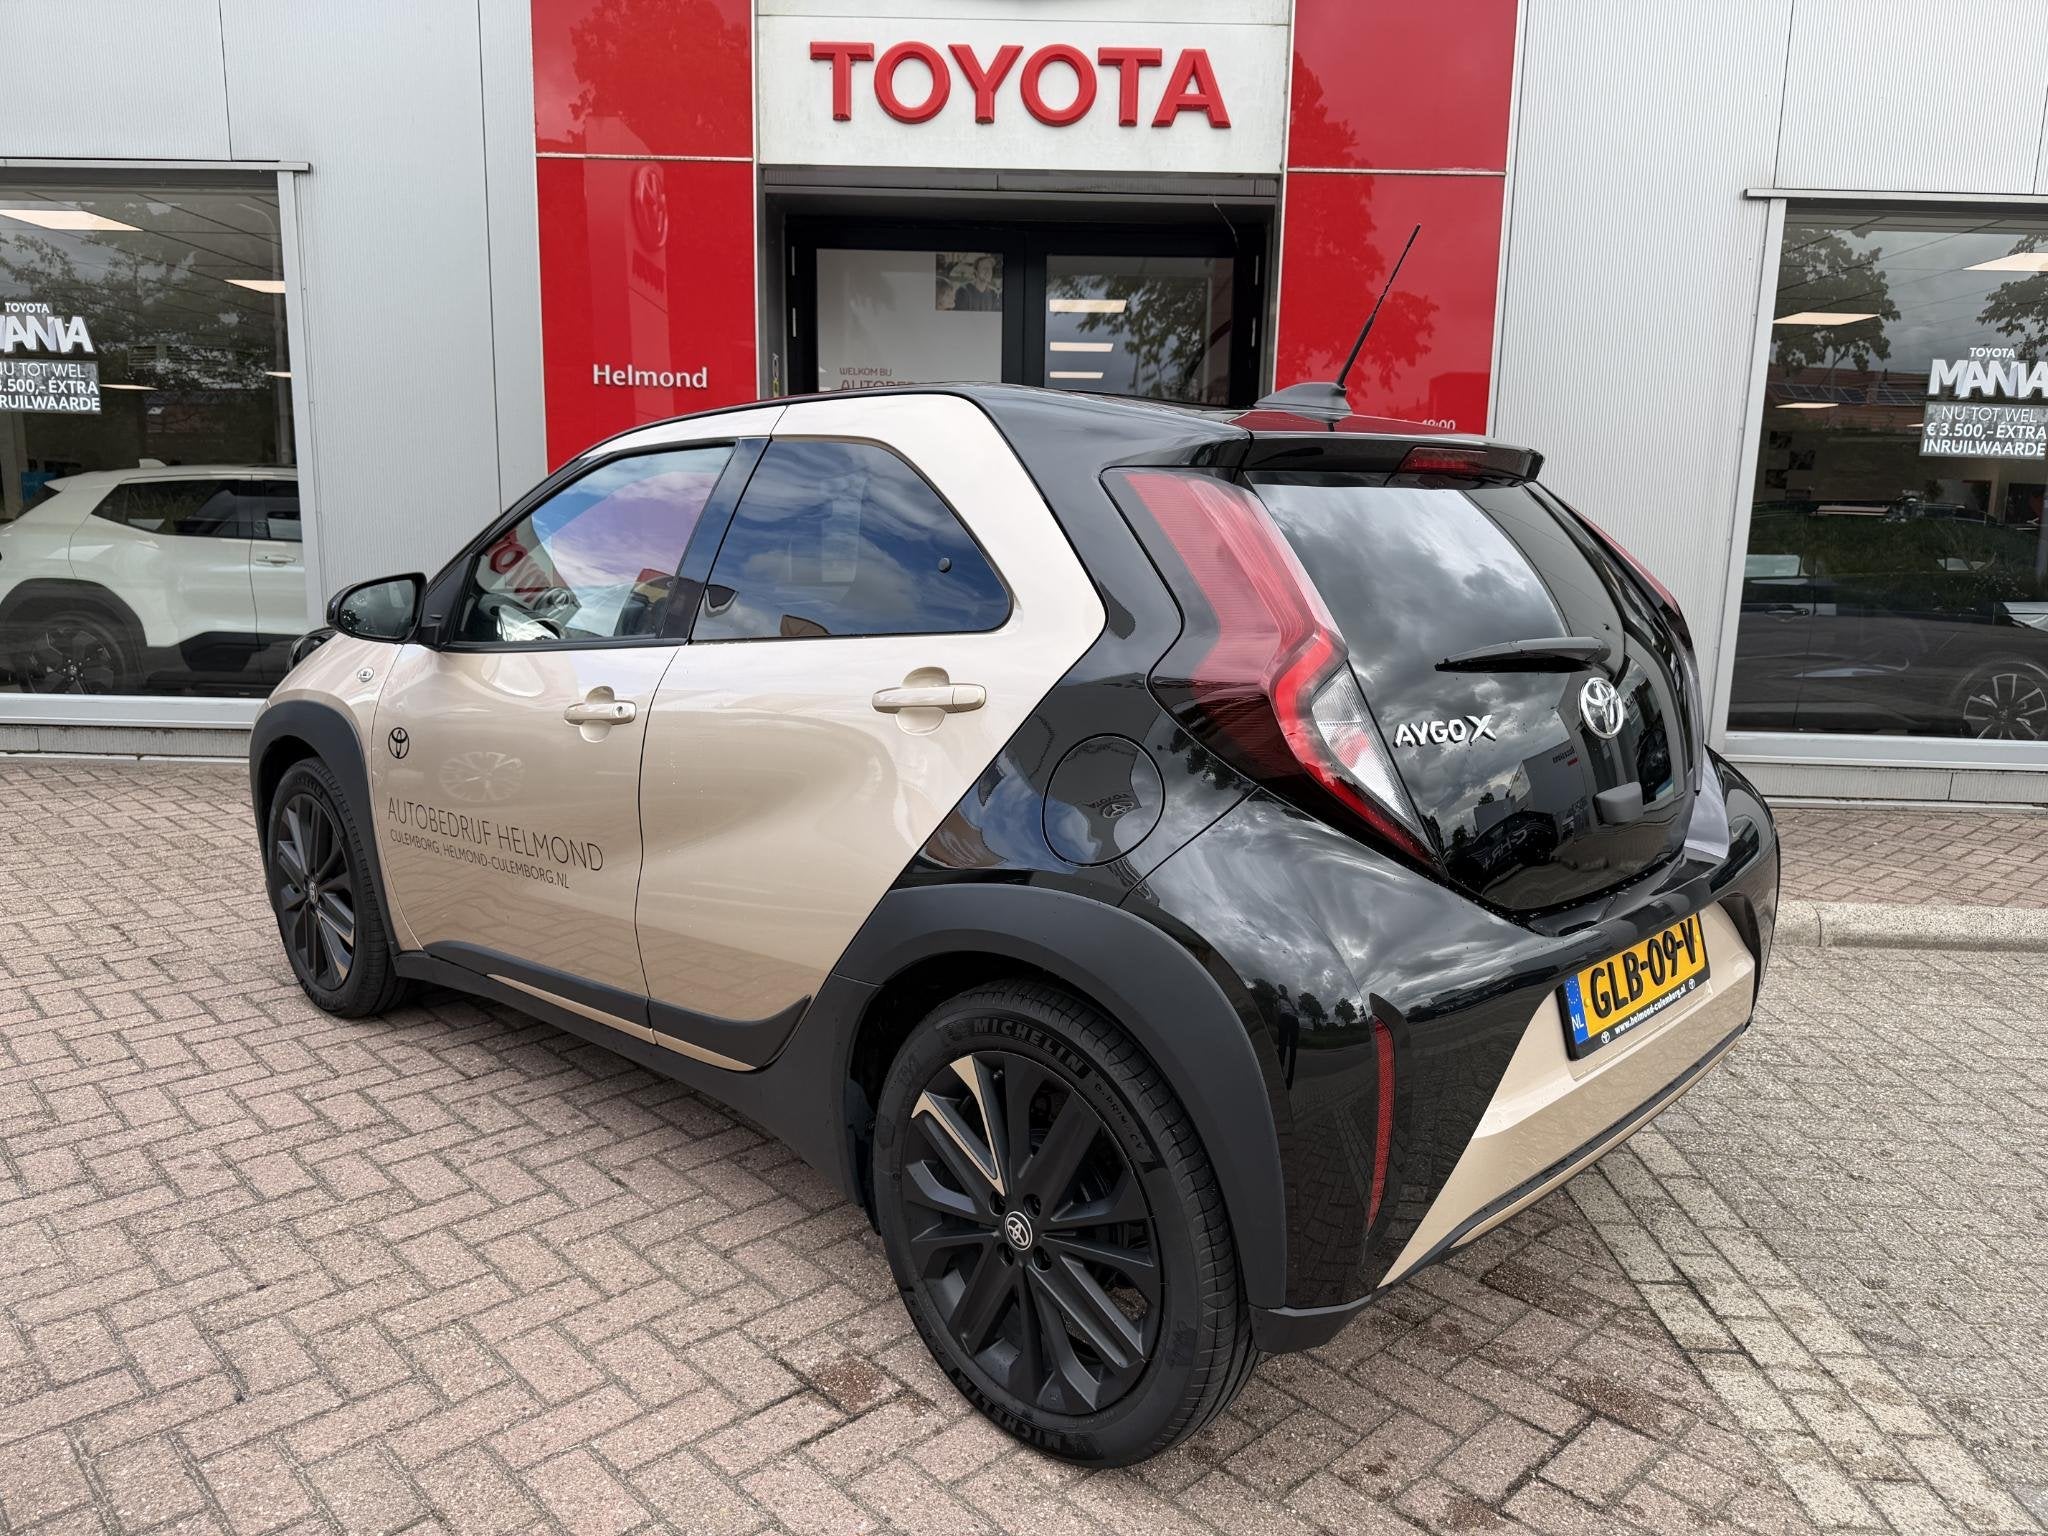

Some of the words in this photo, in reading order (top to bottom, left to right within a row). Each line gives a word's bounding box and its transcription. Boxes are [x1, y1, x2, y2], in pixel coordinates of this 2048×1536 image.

[809, 40, 1232, 129] TOYOTA
[5, 302, 50, 313] TOYOTA
[0, 315, 95, 353] ANIA
[1969, 347, 2016, 359] TOYOTA
[18, 362, 48, 376] TOT
[52, 363, 85, 377] WEL
[592, 363, 708, 389] Helmond
[839, 368, 878, 376] WELKOM
[1941, 406, 1966, 421] NU
[1971, 407, 2001, 422] TOT
[2005, 408, 2038, 423] WEL
[1926, 422, 1937, 437] €
[1940, 423, 1994, 440] 3.500,-
[1923, 439, 2047, 456] INRUILWAARDE
[387, 797, 493, 846] AUTOBEDRIJF
[496, 822, 604, 873] HELMOND
[443, 846, 570, 889] HELMOND-CULEMBORG.NL
[1590, 917, 1697, 1019] GLB-09-V
[1614, 983, 1687, 1035] www.helmond-culemborg.nl
[1570, 1013, 1585, 1033] NL
[973, 1018, 1084, 1075] MICHELIN
